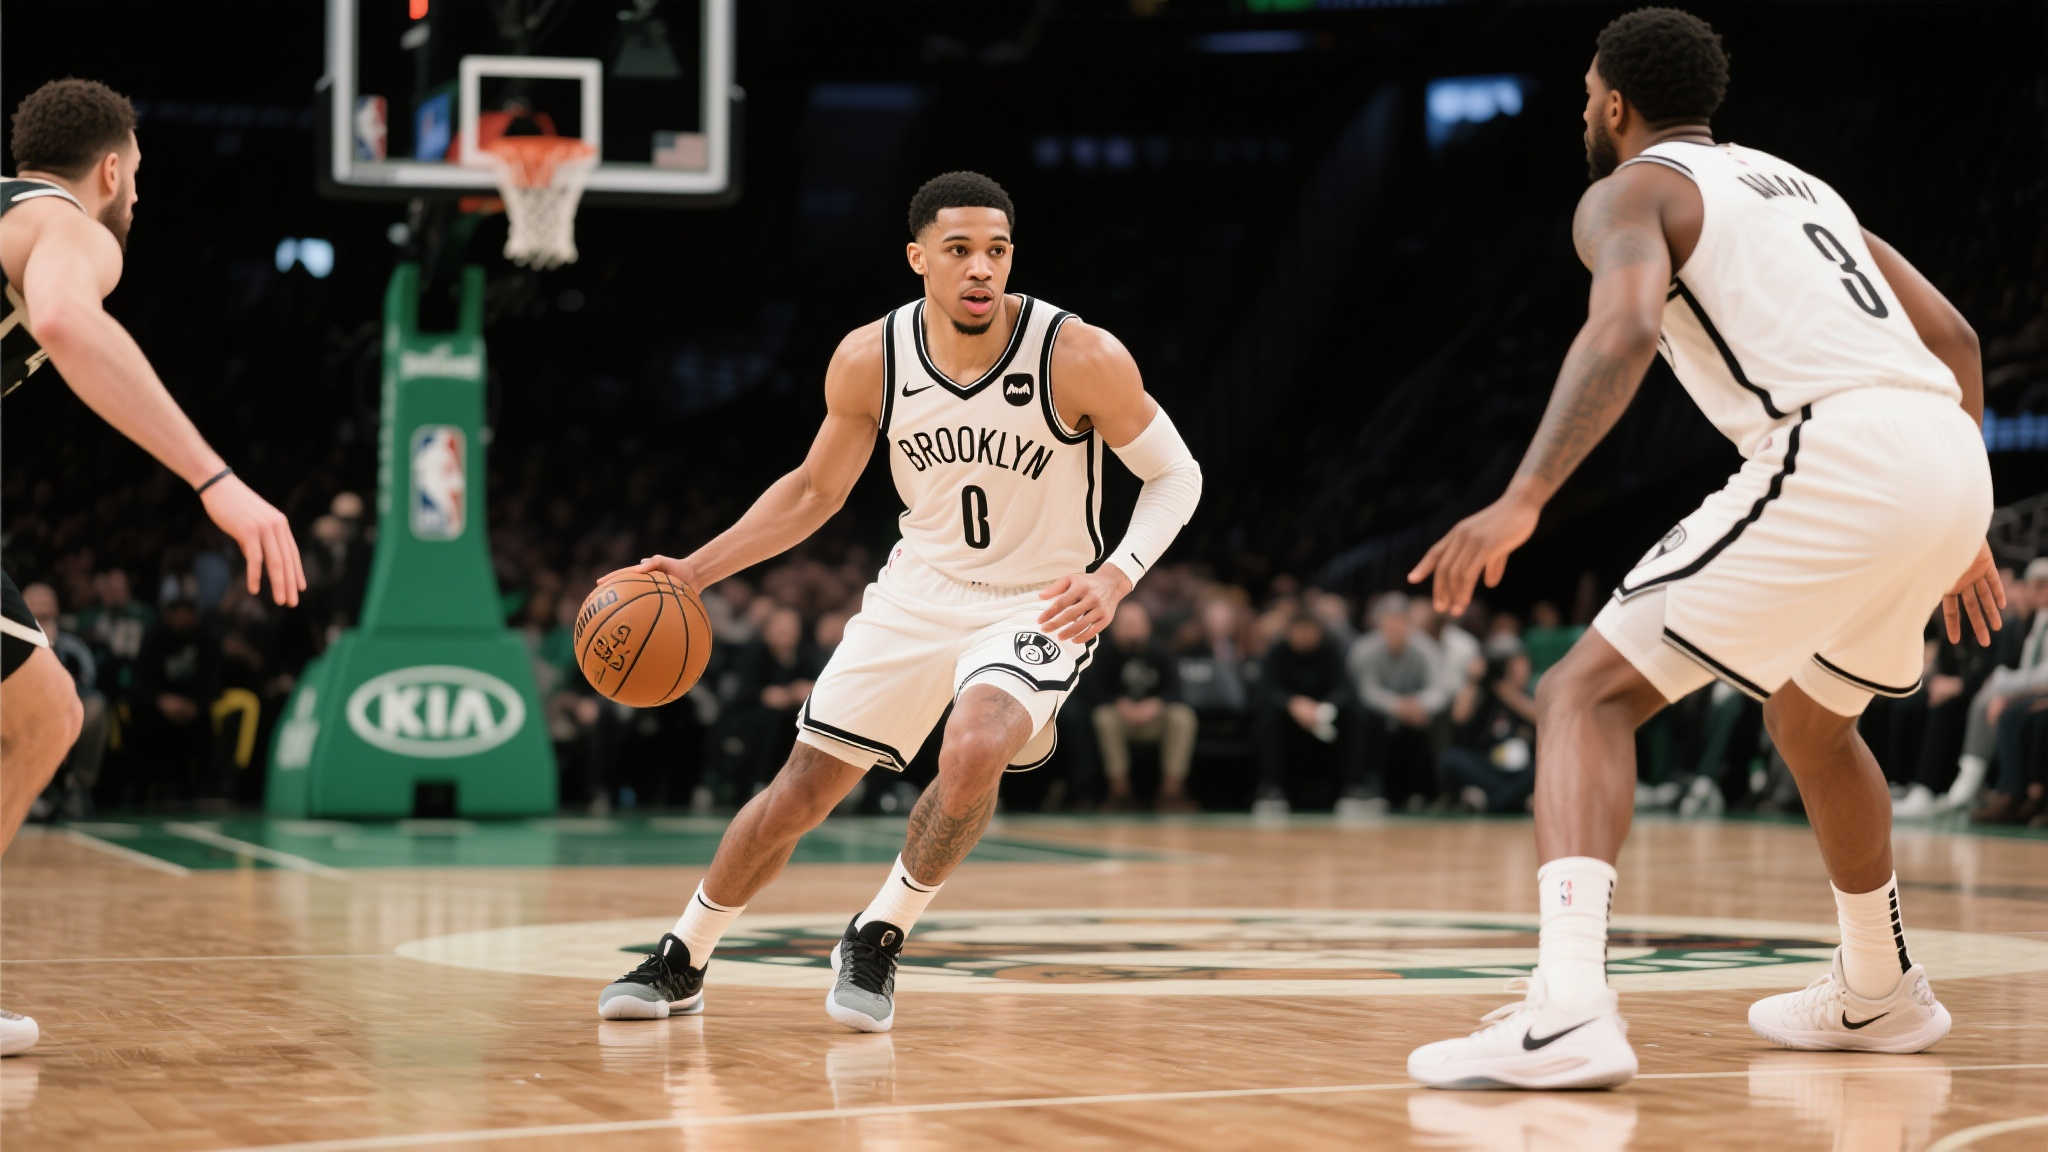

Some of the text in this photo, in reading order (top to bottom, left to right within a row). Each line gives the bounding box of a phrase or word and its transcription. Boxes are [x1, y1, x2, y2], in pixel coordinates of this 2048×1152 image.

[1803, 223, 1889, 319] 3
[898, 425, 1054, 481] BROOKLYN
[379, 683, 498, 740] KIA
